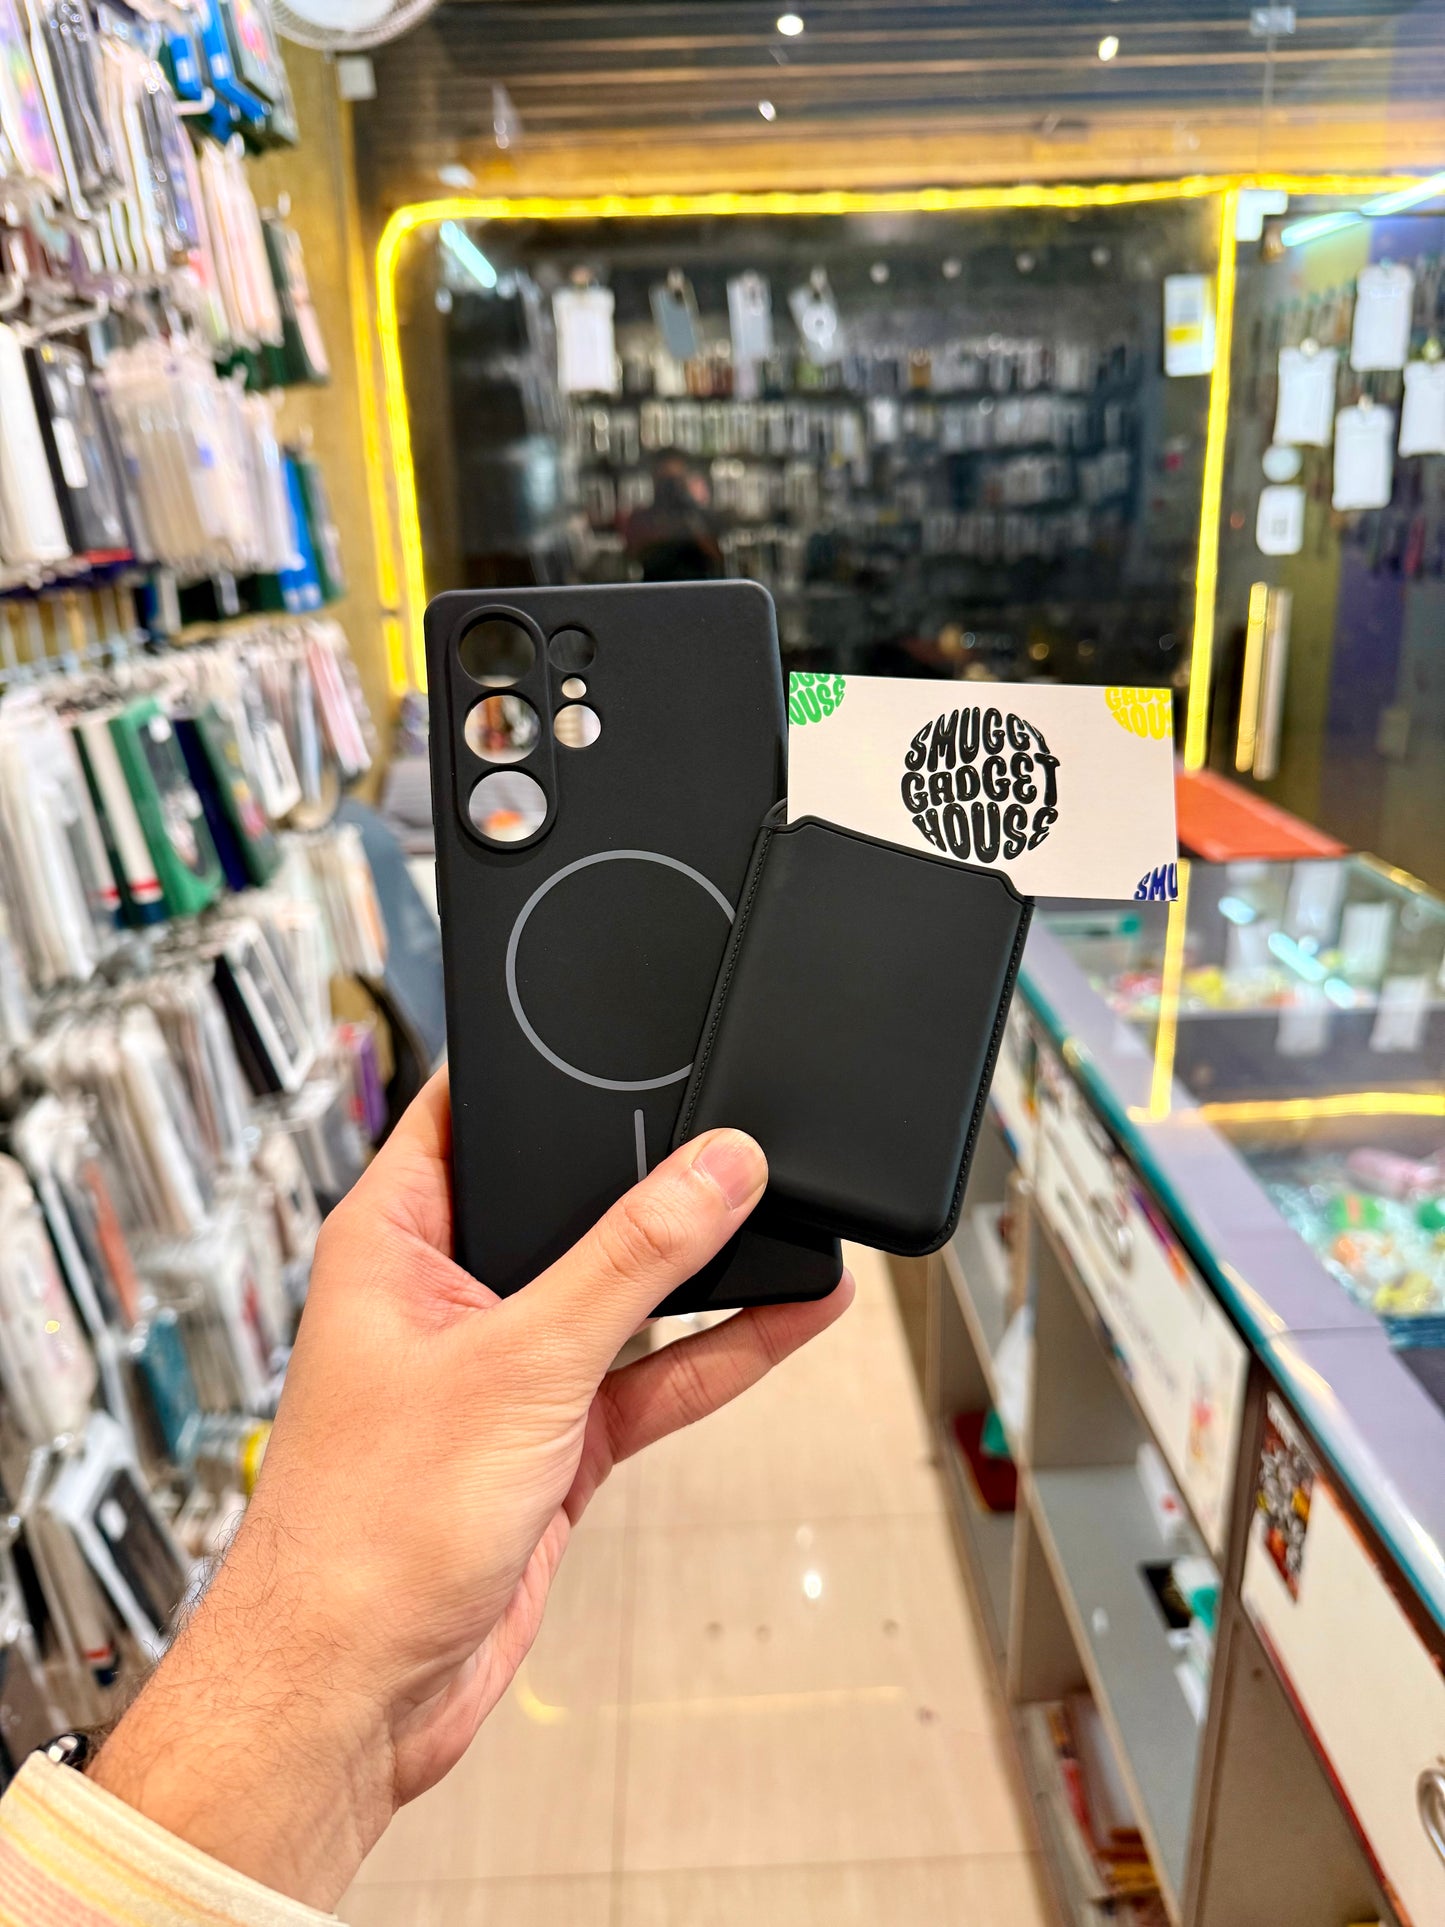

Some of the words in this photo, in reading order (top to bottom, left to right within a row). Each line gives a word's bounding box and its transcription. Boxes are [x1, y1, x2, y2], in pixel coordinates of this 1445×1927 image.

[790, 678, 846, 725] OUSE
[905, 707, 1050, 772] SMUGGY
[901, 752, 1060, 814] GADGET
[912, 802, 1058, 863] HOUSE
